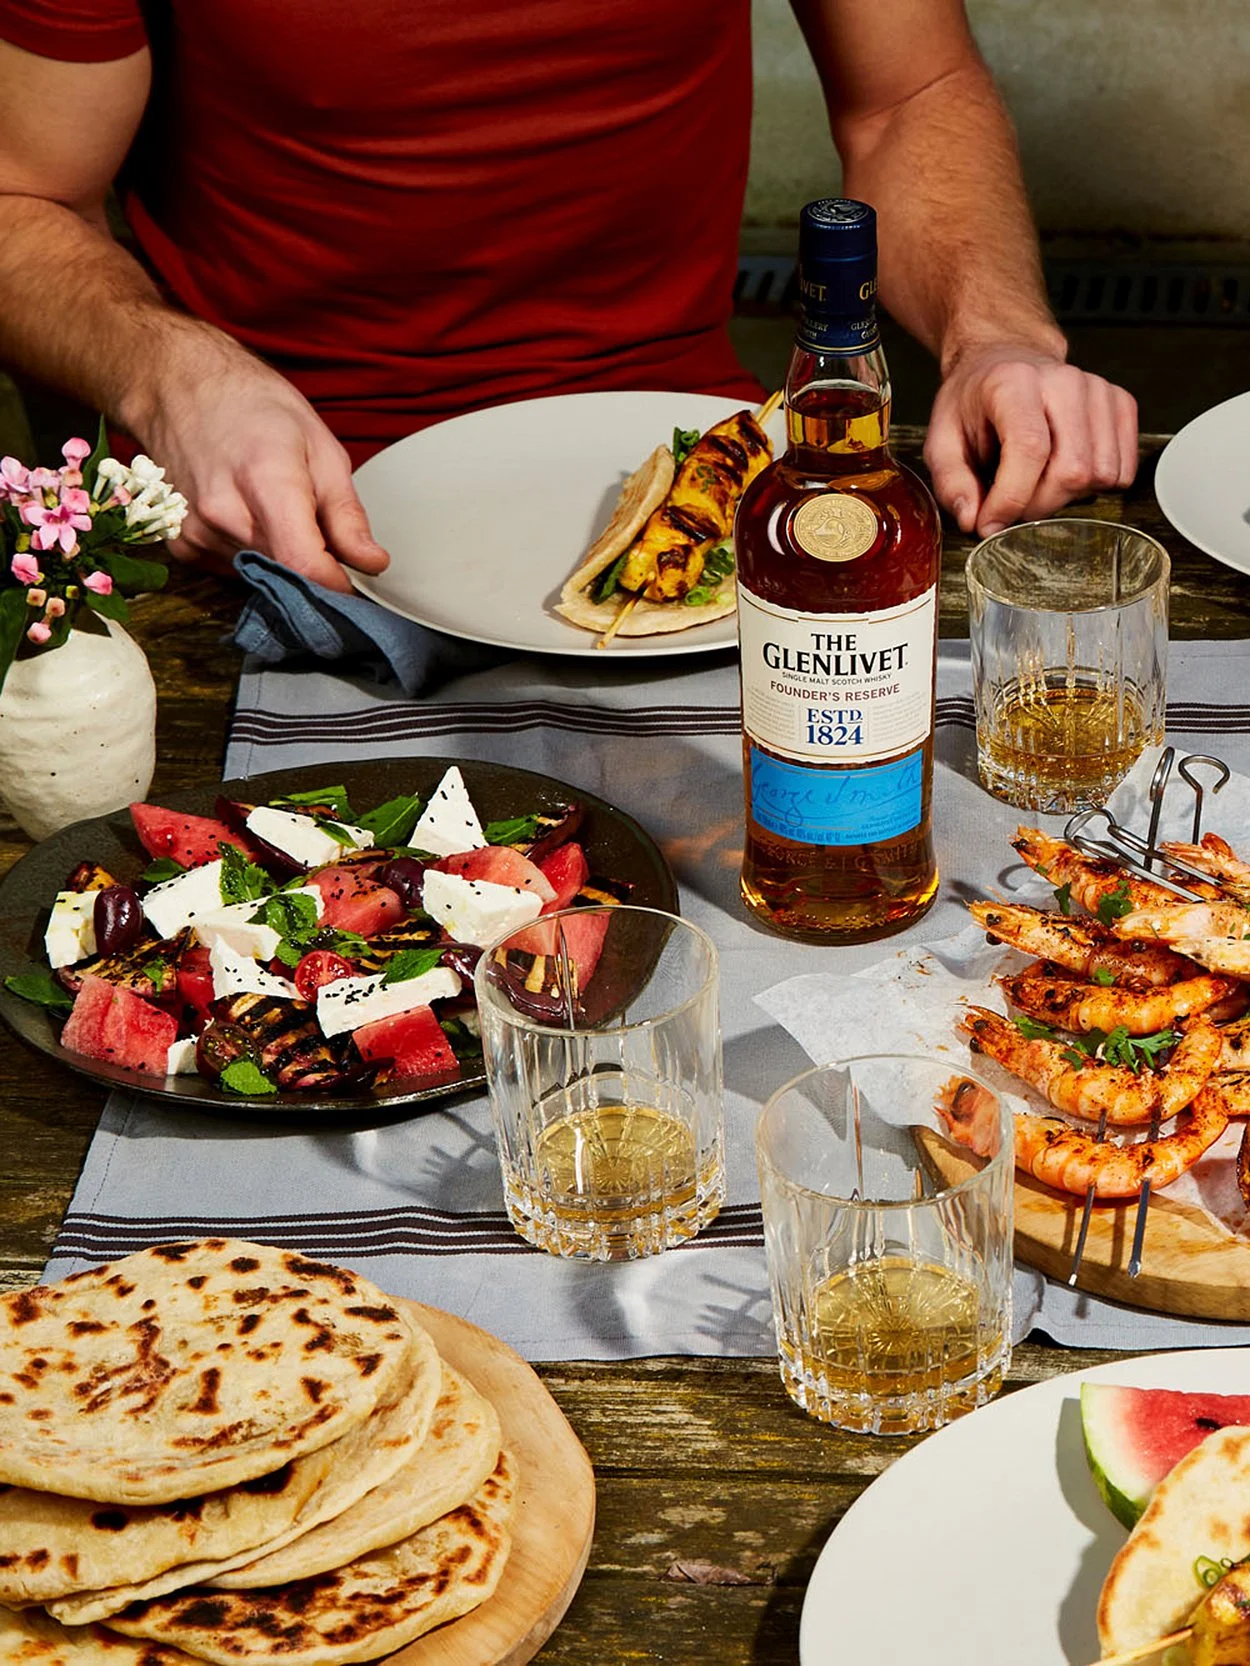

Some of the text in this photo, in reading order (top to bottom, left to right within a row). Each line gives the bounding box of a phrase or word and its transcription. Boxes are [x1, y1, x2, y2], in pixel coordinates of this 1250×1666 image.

[810, 633, 856, 651] THE
[762, 642, 908, 676] GLENLIVET
[782, 671, 892, 686] SINGLE MALT SCOTCH WHISKY
[770, 680, 901, 702] FOUNDER'S RESERVE
[806, 724, 864, 746] 1824
